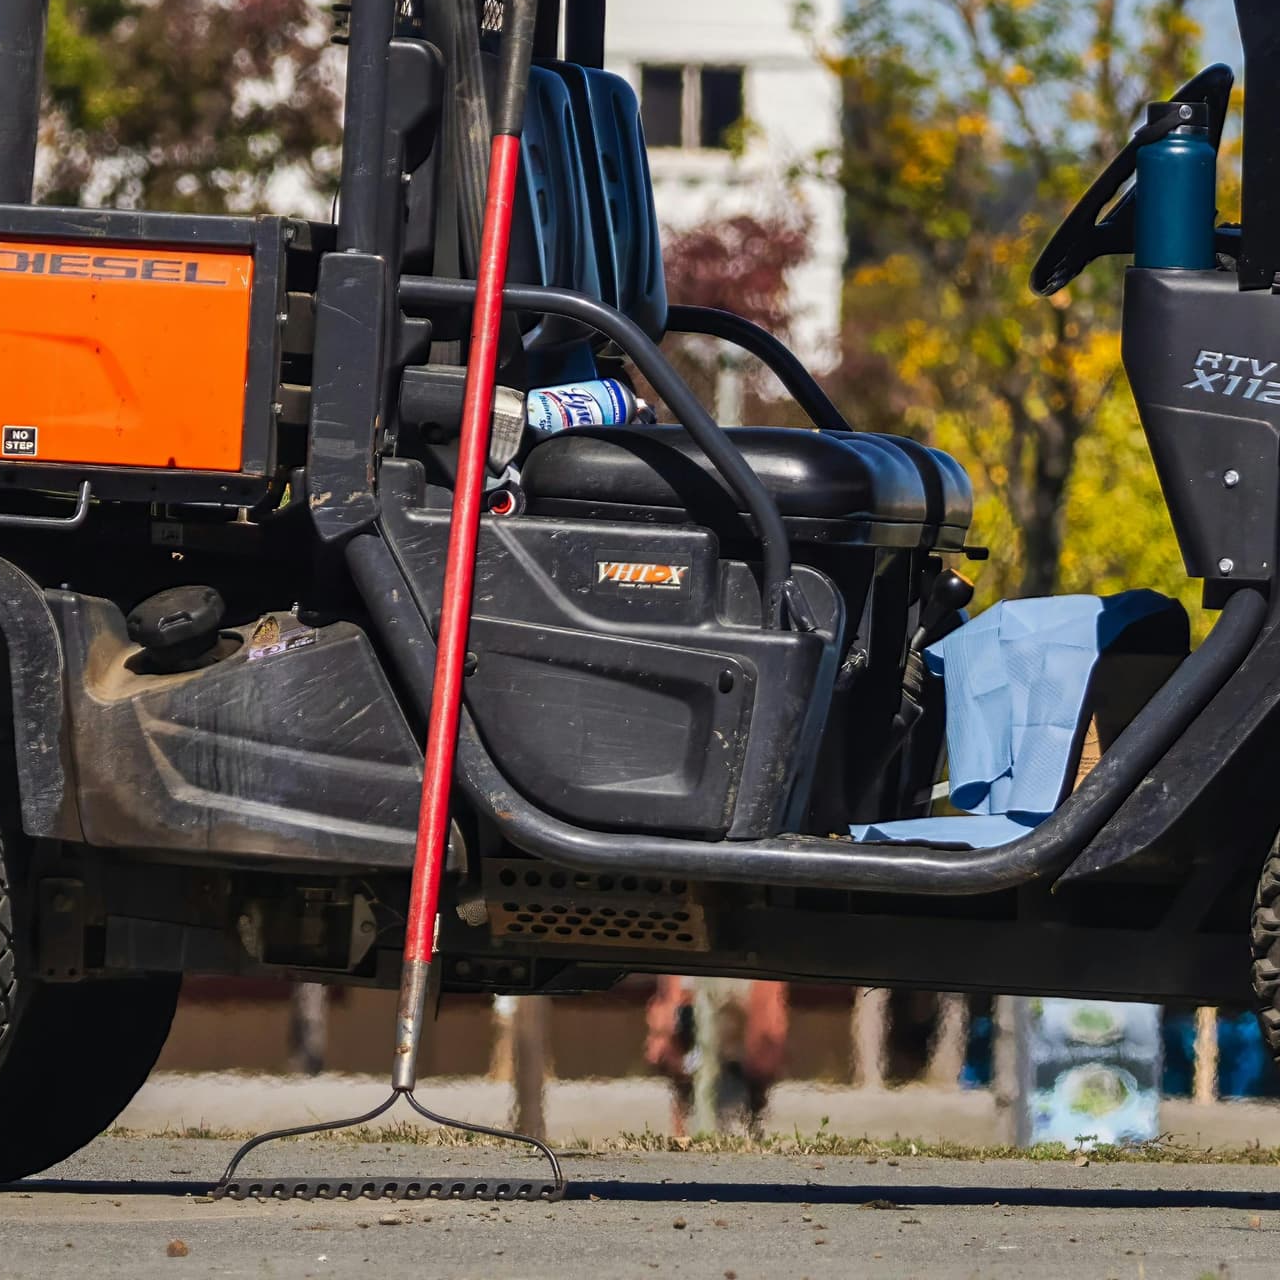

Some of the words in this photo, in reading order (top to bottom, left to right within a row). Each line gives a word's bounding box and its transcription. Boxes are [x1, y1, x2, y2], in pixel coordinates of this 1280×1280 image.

[1195, 350, 1278, 377] RTV
[557, 387, 594, 425] Lyso
[5, 440, 34, 450] STEP
[12, 430, 29, 440] NO
[597, 561, 688, 584] VHT-X
